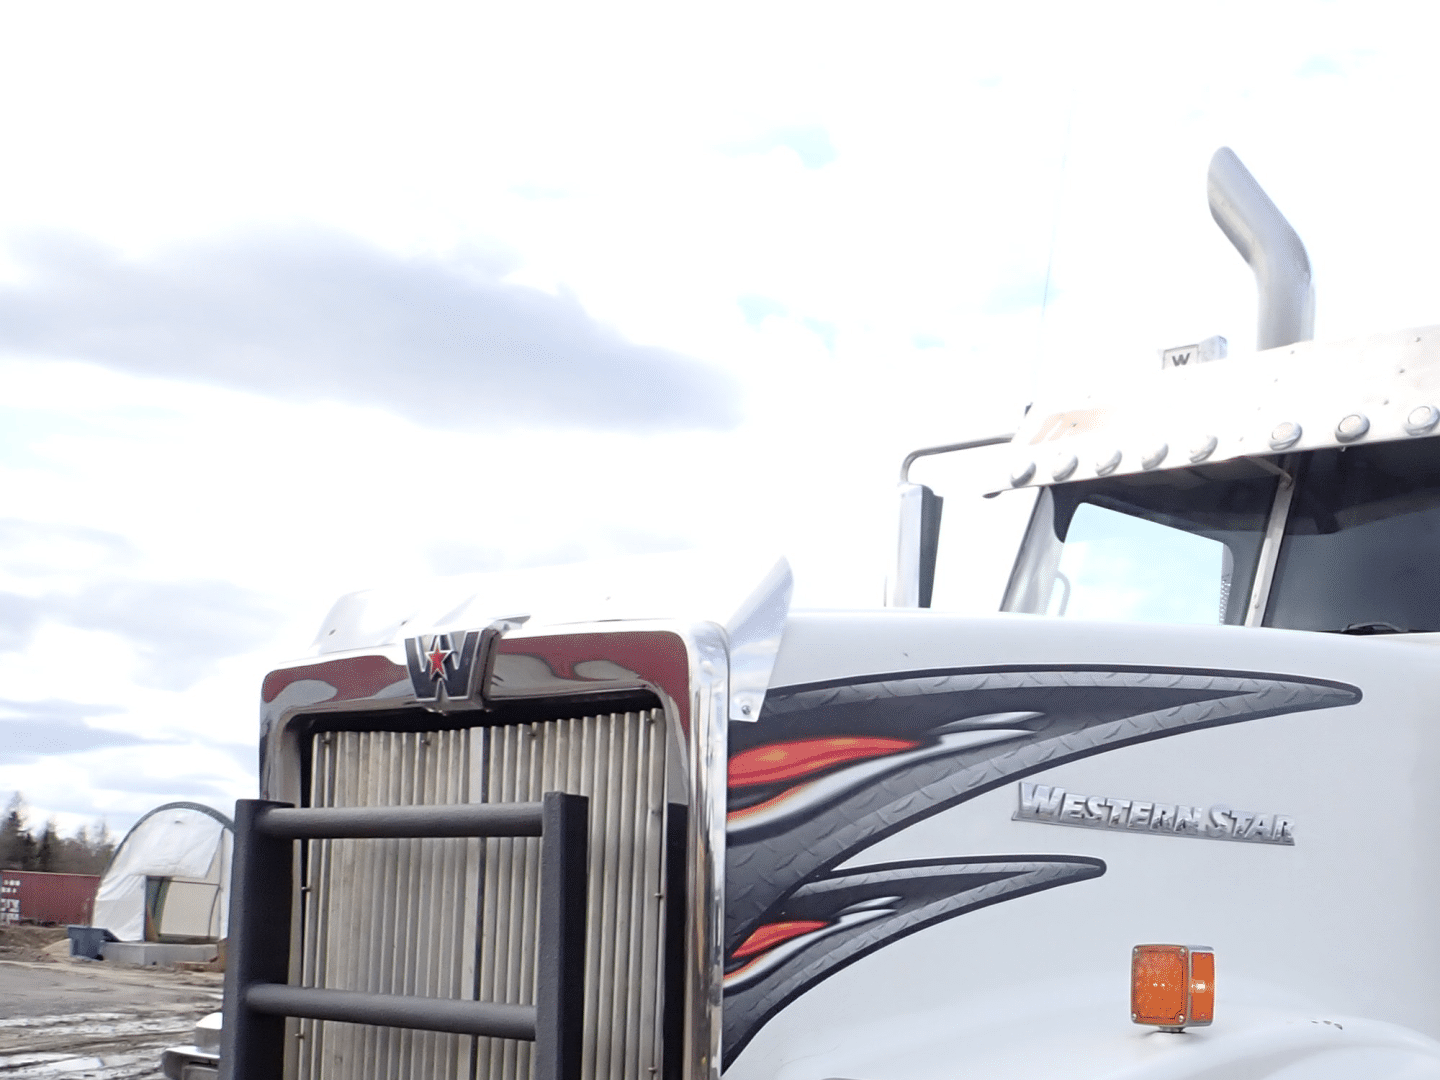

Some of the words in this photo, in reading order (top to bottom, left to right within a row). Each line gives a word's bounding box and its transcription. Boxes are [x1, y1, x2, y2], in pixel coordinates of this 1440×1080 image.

[1172, 352, 1191, 367] W
[404, 630, 481, 701] W
[1018, 781, 1202, 835] WESTERN
[1206, 802, 1296, 842] STAR
